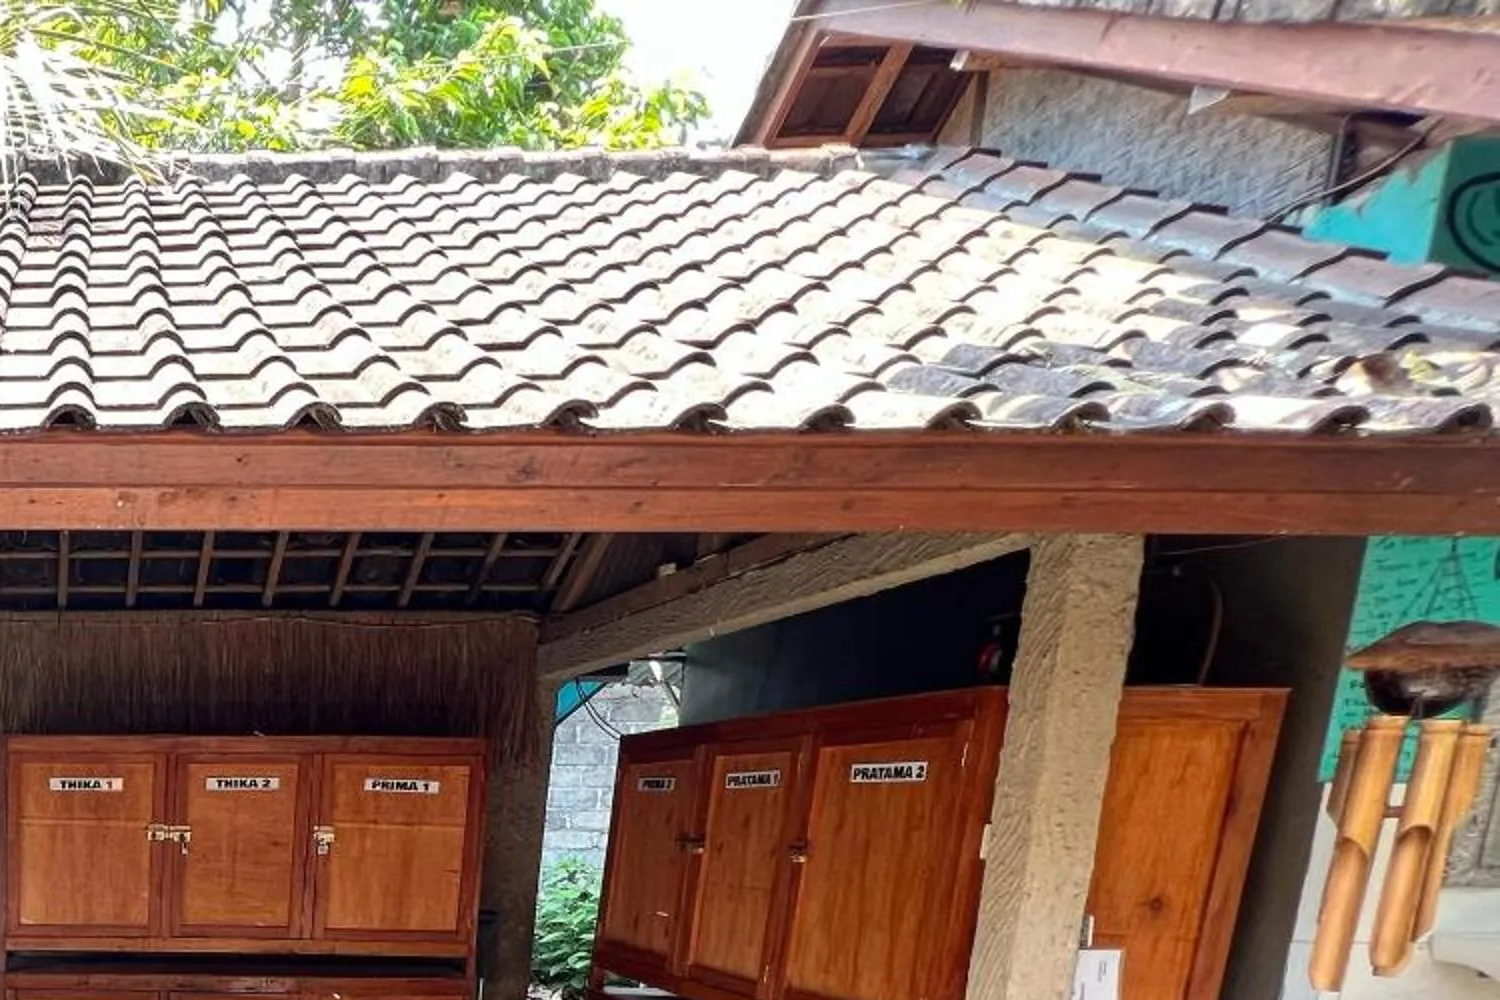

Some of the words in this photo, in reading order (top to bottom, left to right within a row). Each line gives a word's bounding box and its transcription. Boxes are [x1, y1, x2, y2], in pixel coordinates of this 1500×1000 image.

[853, 765, 913, 780] PRATAMA
[59, 779, 101, 789] THIKA
[216, 779, 258, 788] THIKA
[371, 779, 419, 791] PRIMA
[727, 773, 771, 786] PRATAMA
